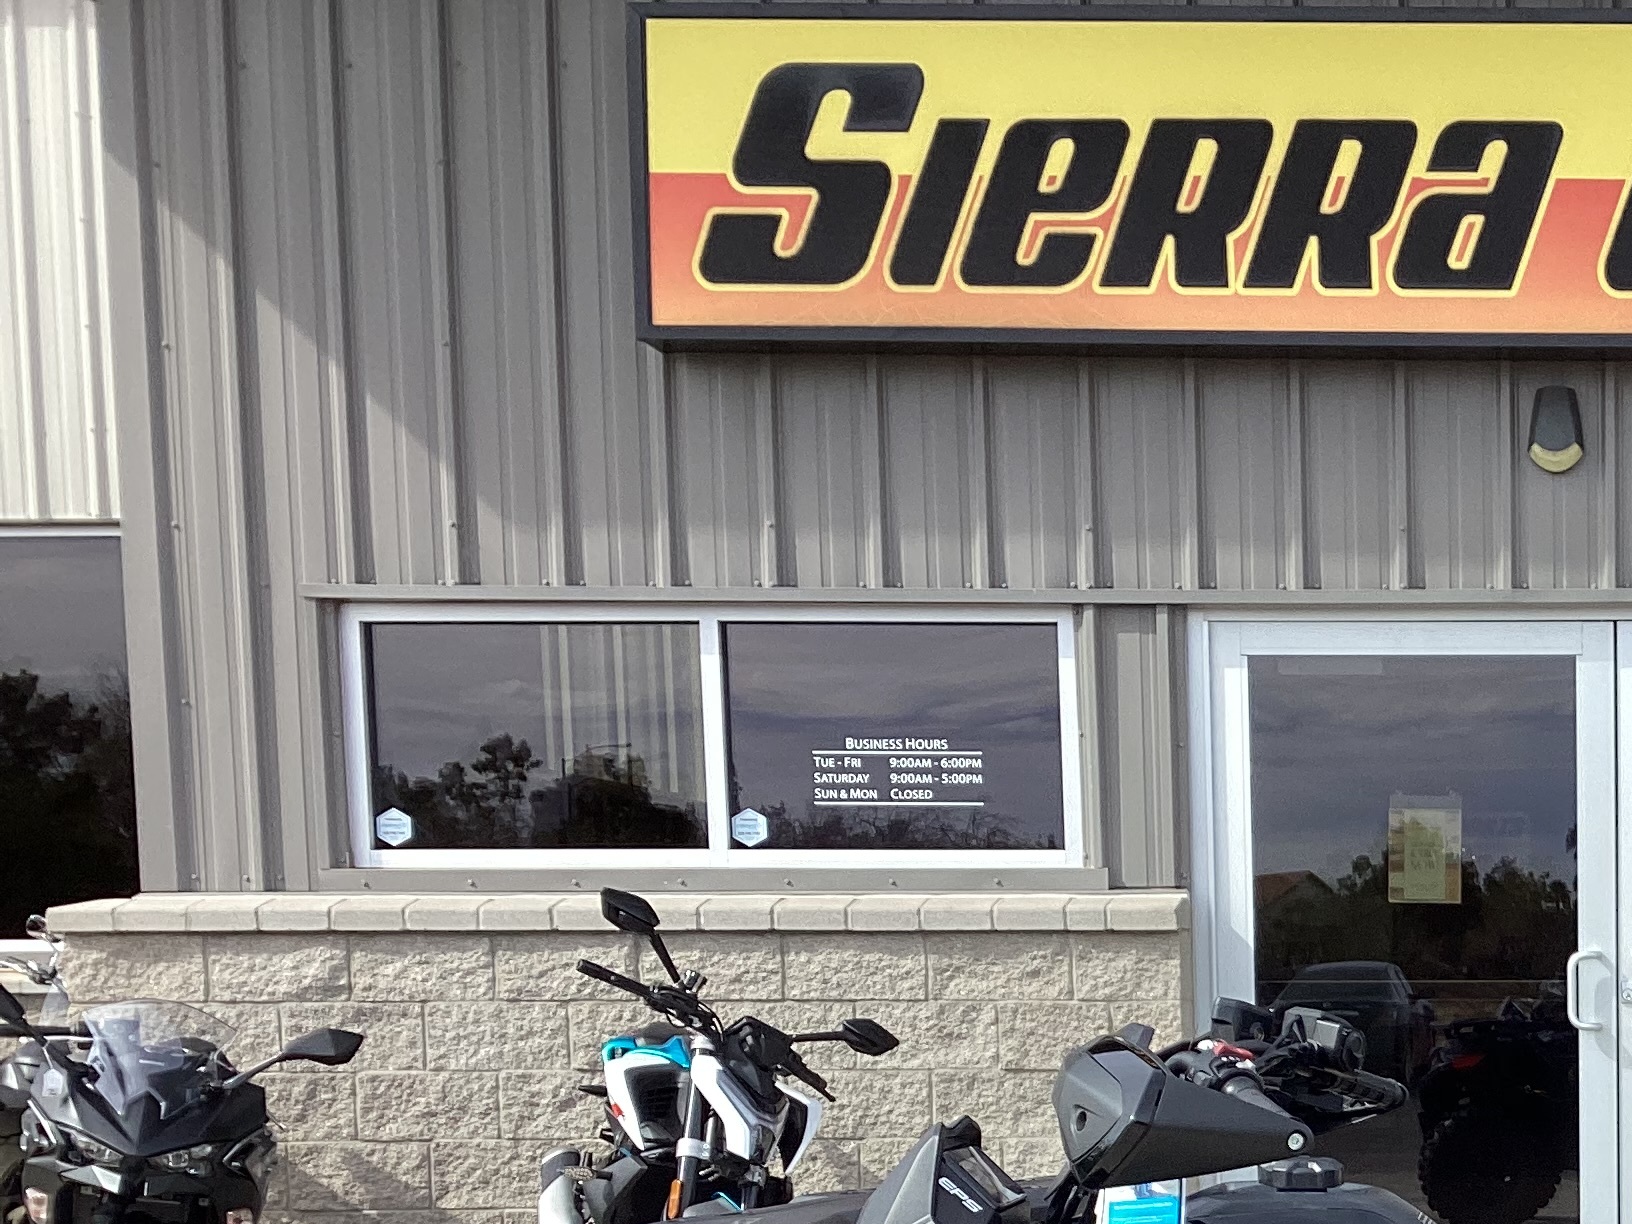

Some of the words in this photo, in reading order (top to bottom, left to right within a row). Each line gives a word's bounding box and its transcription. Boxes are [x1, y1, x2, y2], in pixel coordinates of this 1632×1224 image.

[889, 757, 932, 768] 9:00AM
[940, 757, 982, 769] 6:00PM
[889, 772, 932, 784] 9:00AM
[941, 772, 983, 784] 5:00PM
[839, 788, 848, 799] &
[938, 1176, 983, 1213] EPS
